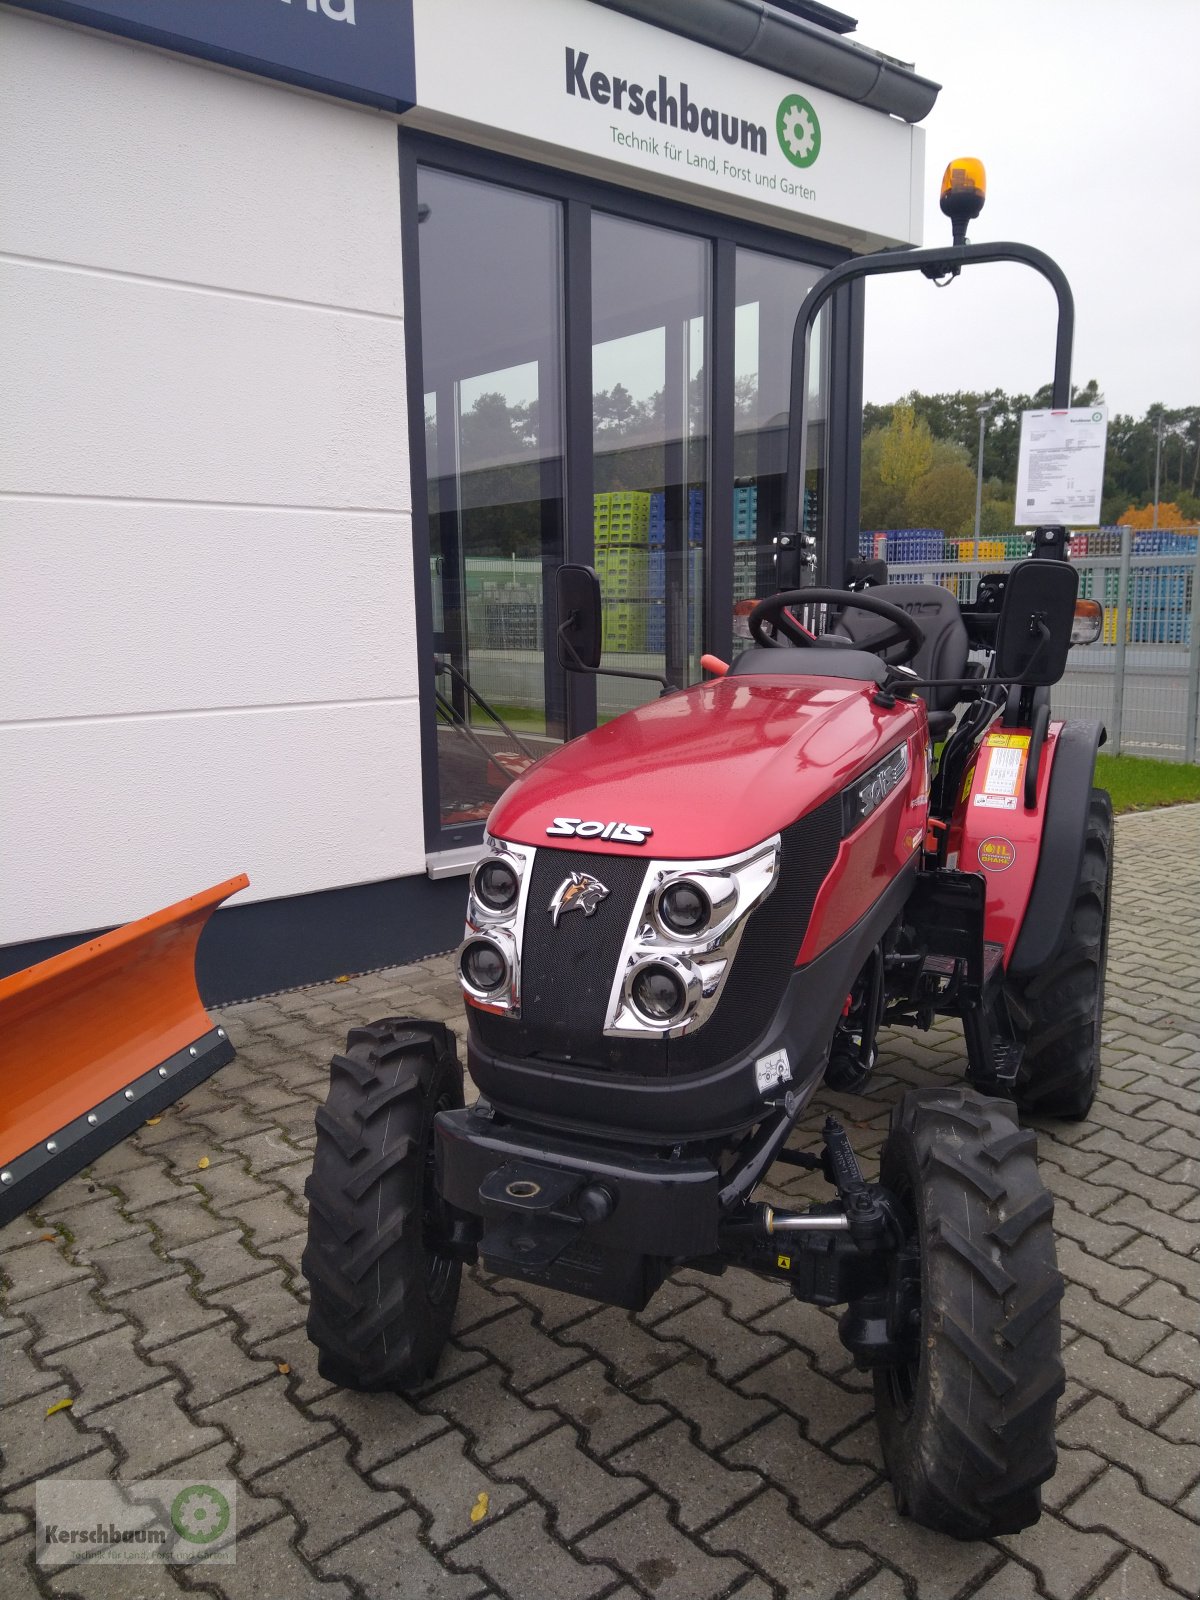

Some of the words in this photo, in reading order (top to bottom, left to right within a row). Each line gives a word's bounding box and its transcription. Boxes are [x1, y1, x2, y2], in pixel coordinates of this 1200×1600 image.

[565, 46, 767, 156] Kerschbaum
[610, 126, 659, 155] Technik
[664, 141, 682, 162] für
[687, 149, 719, 175] Land,
[723, 160, 751, 183] Forst
[755, 173, 777, 190] und
[780, 178, 816, 201] Garten
